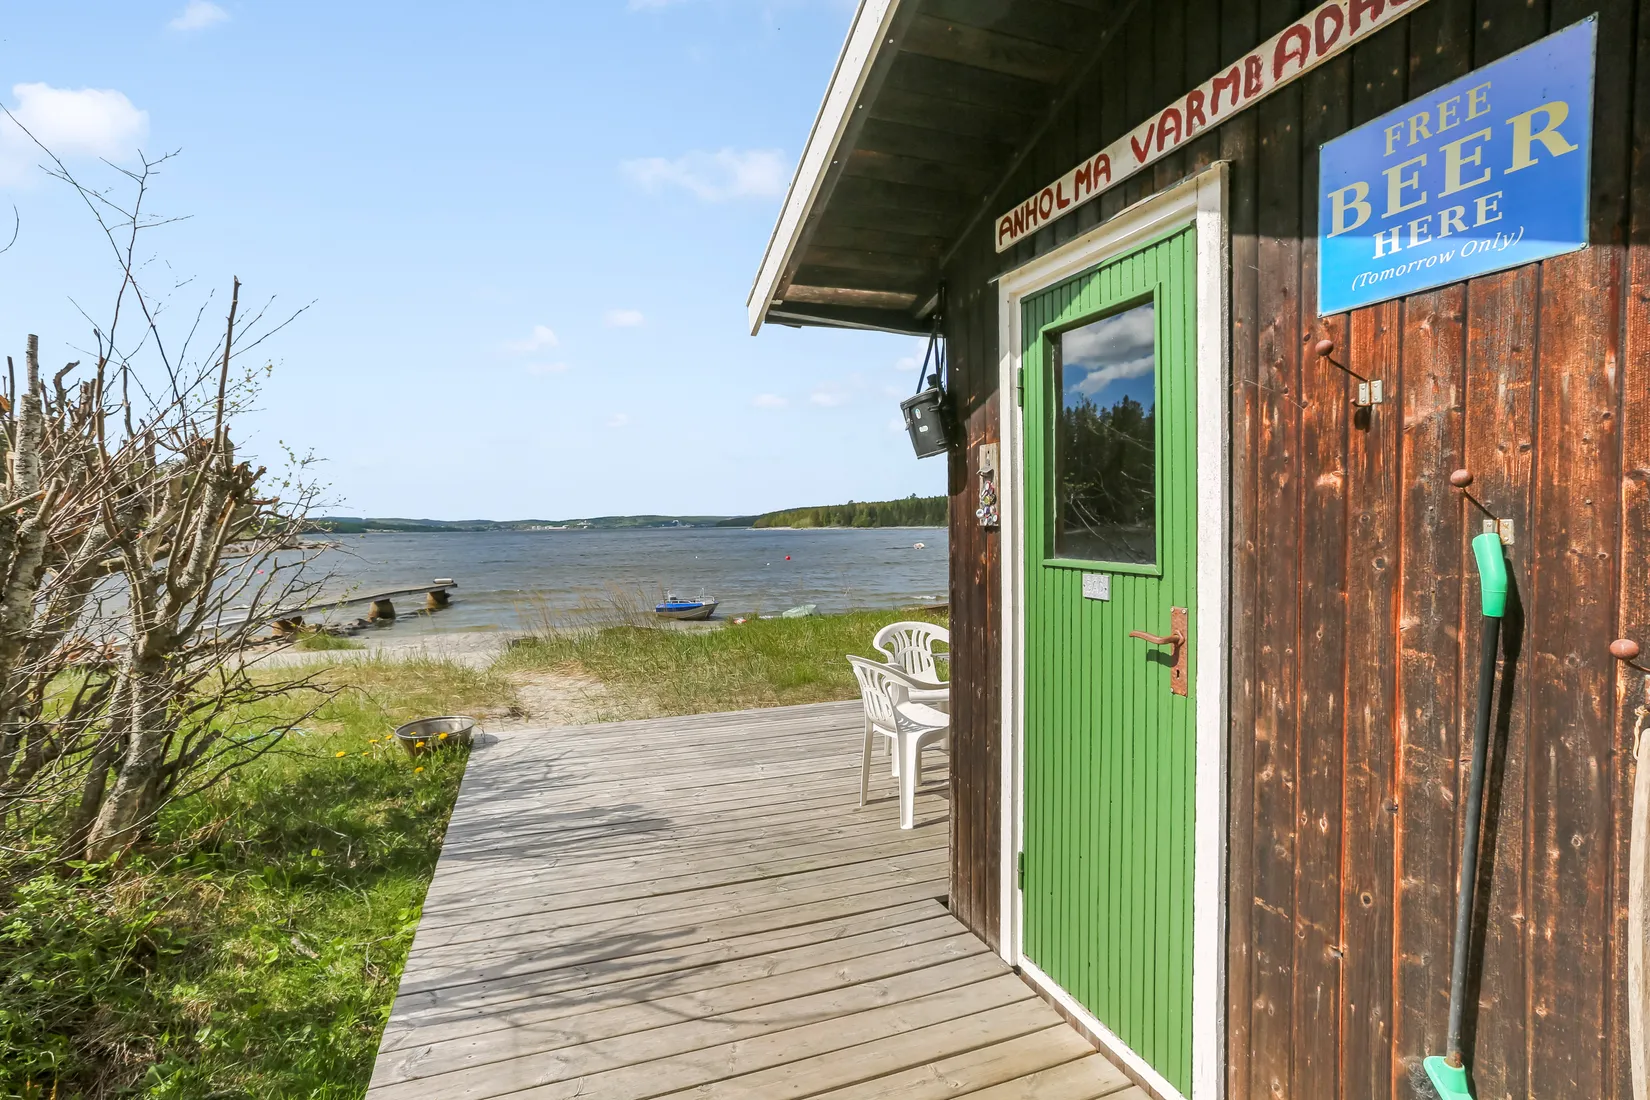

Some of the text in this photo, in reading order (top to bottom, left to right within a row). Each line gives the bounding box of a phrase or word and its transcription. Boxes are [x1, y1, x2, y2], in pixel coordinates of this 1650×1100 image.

[999, 0, 1409, 246] ANHOLMA VARMBADH
[1383, 81, 1492, 157] FREE
[1326, 101, 1579, 239] BEER
[1351, 226, 1524, 291] (Tomorrow Only)
[1372, 191, 1503, 260] HERE
